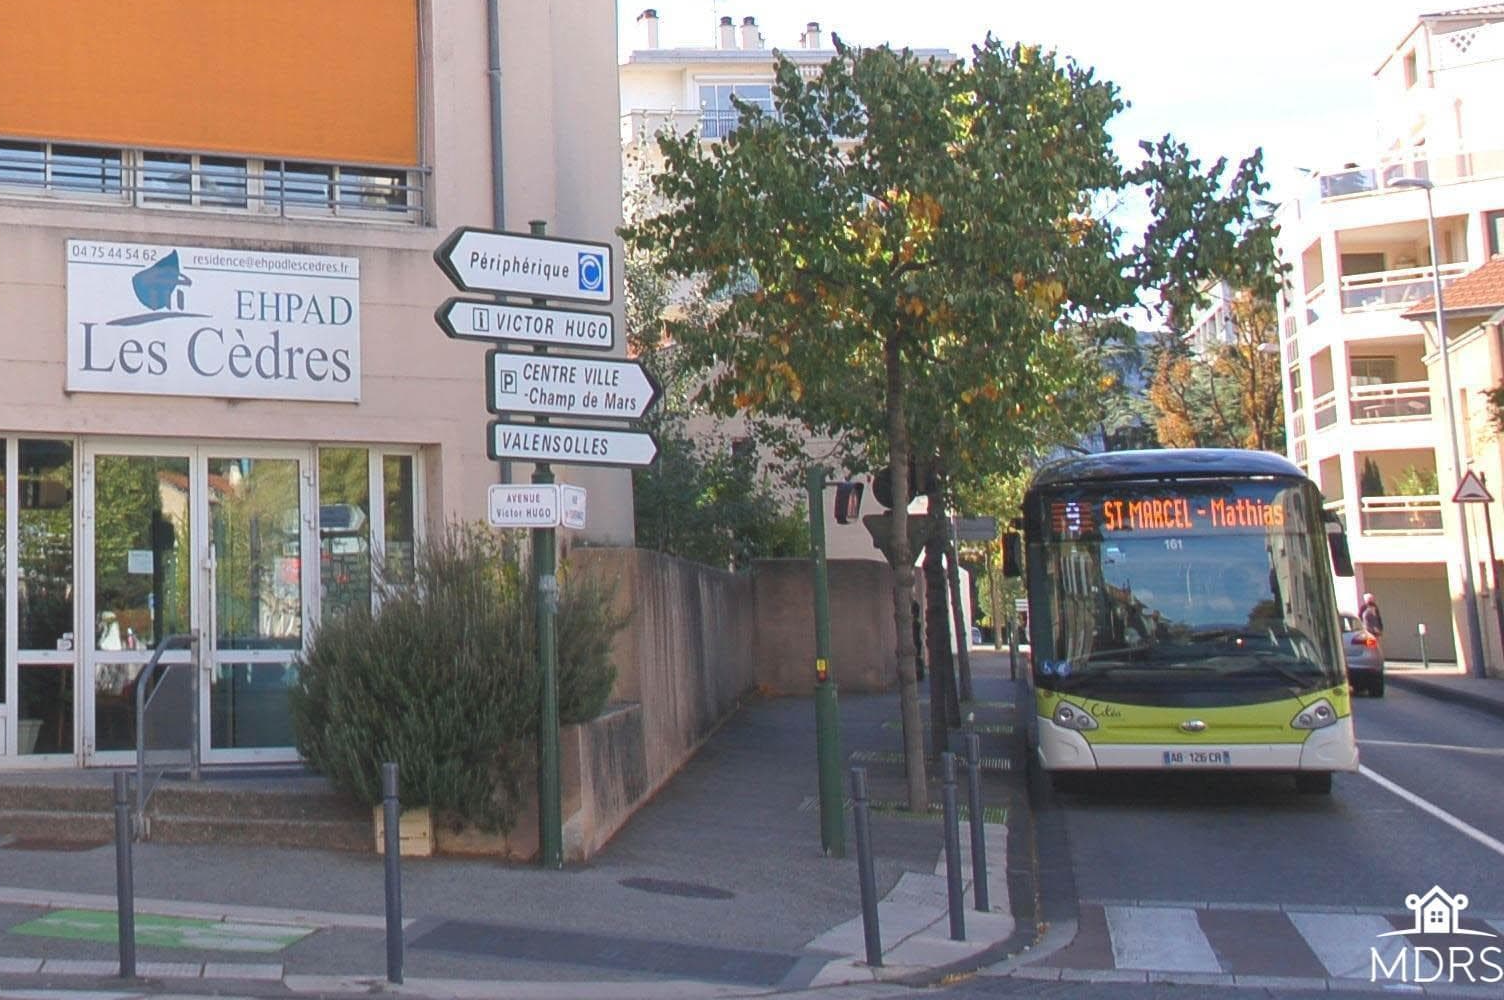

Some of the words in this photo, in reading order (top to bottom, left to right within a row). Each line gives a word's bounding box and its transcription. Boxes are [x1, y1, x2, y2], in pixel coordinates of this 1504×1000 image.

[72, 245, 87, 257] 04
[91, 246, 105, 258] 75
[108, 247, 122, 259] 44
[125, 248, 139, 260] 54
[142, 249, 157, 261] 62
[193, 253, 349, 274] residence@ehpadlescedres.fr
[470, 252, 570, 280] Périphérique
[236, 289, 353, 325] EHPAD
[496, 313, 555, 335] VICTOR
[565, 319, 608, 340] HUGO
[79, 322, 168, 376] Les
[187, 327, 351, 383] Cèdres
[523, 362, 576, 384] CENTRE
[584, 367, 620, 387] VILLE
[582, 391, 598, 408] de
[604, 392, 637, 411] Mars
[502, 431, 609, 456] VALENSOLLES
[507, 493, 540, 504] AVENUE
[496, 508, 522, 518] Victor
[526, 507, 551, 518] HUGO
[1104, 500, 1123, 530] ST
[1129, 499, 1192, 529] MARCEL
[1210, 498, 1284, 528] Mathias
[1164, 538, 1183, 550] 161
